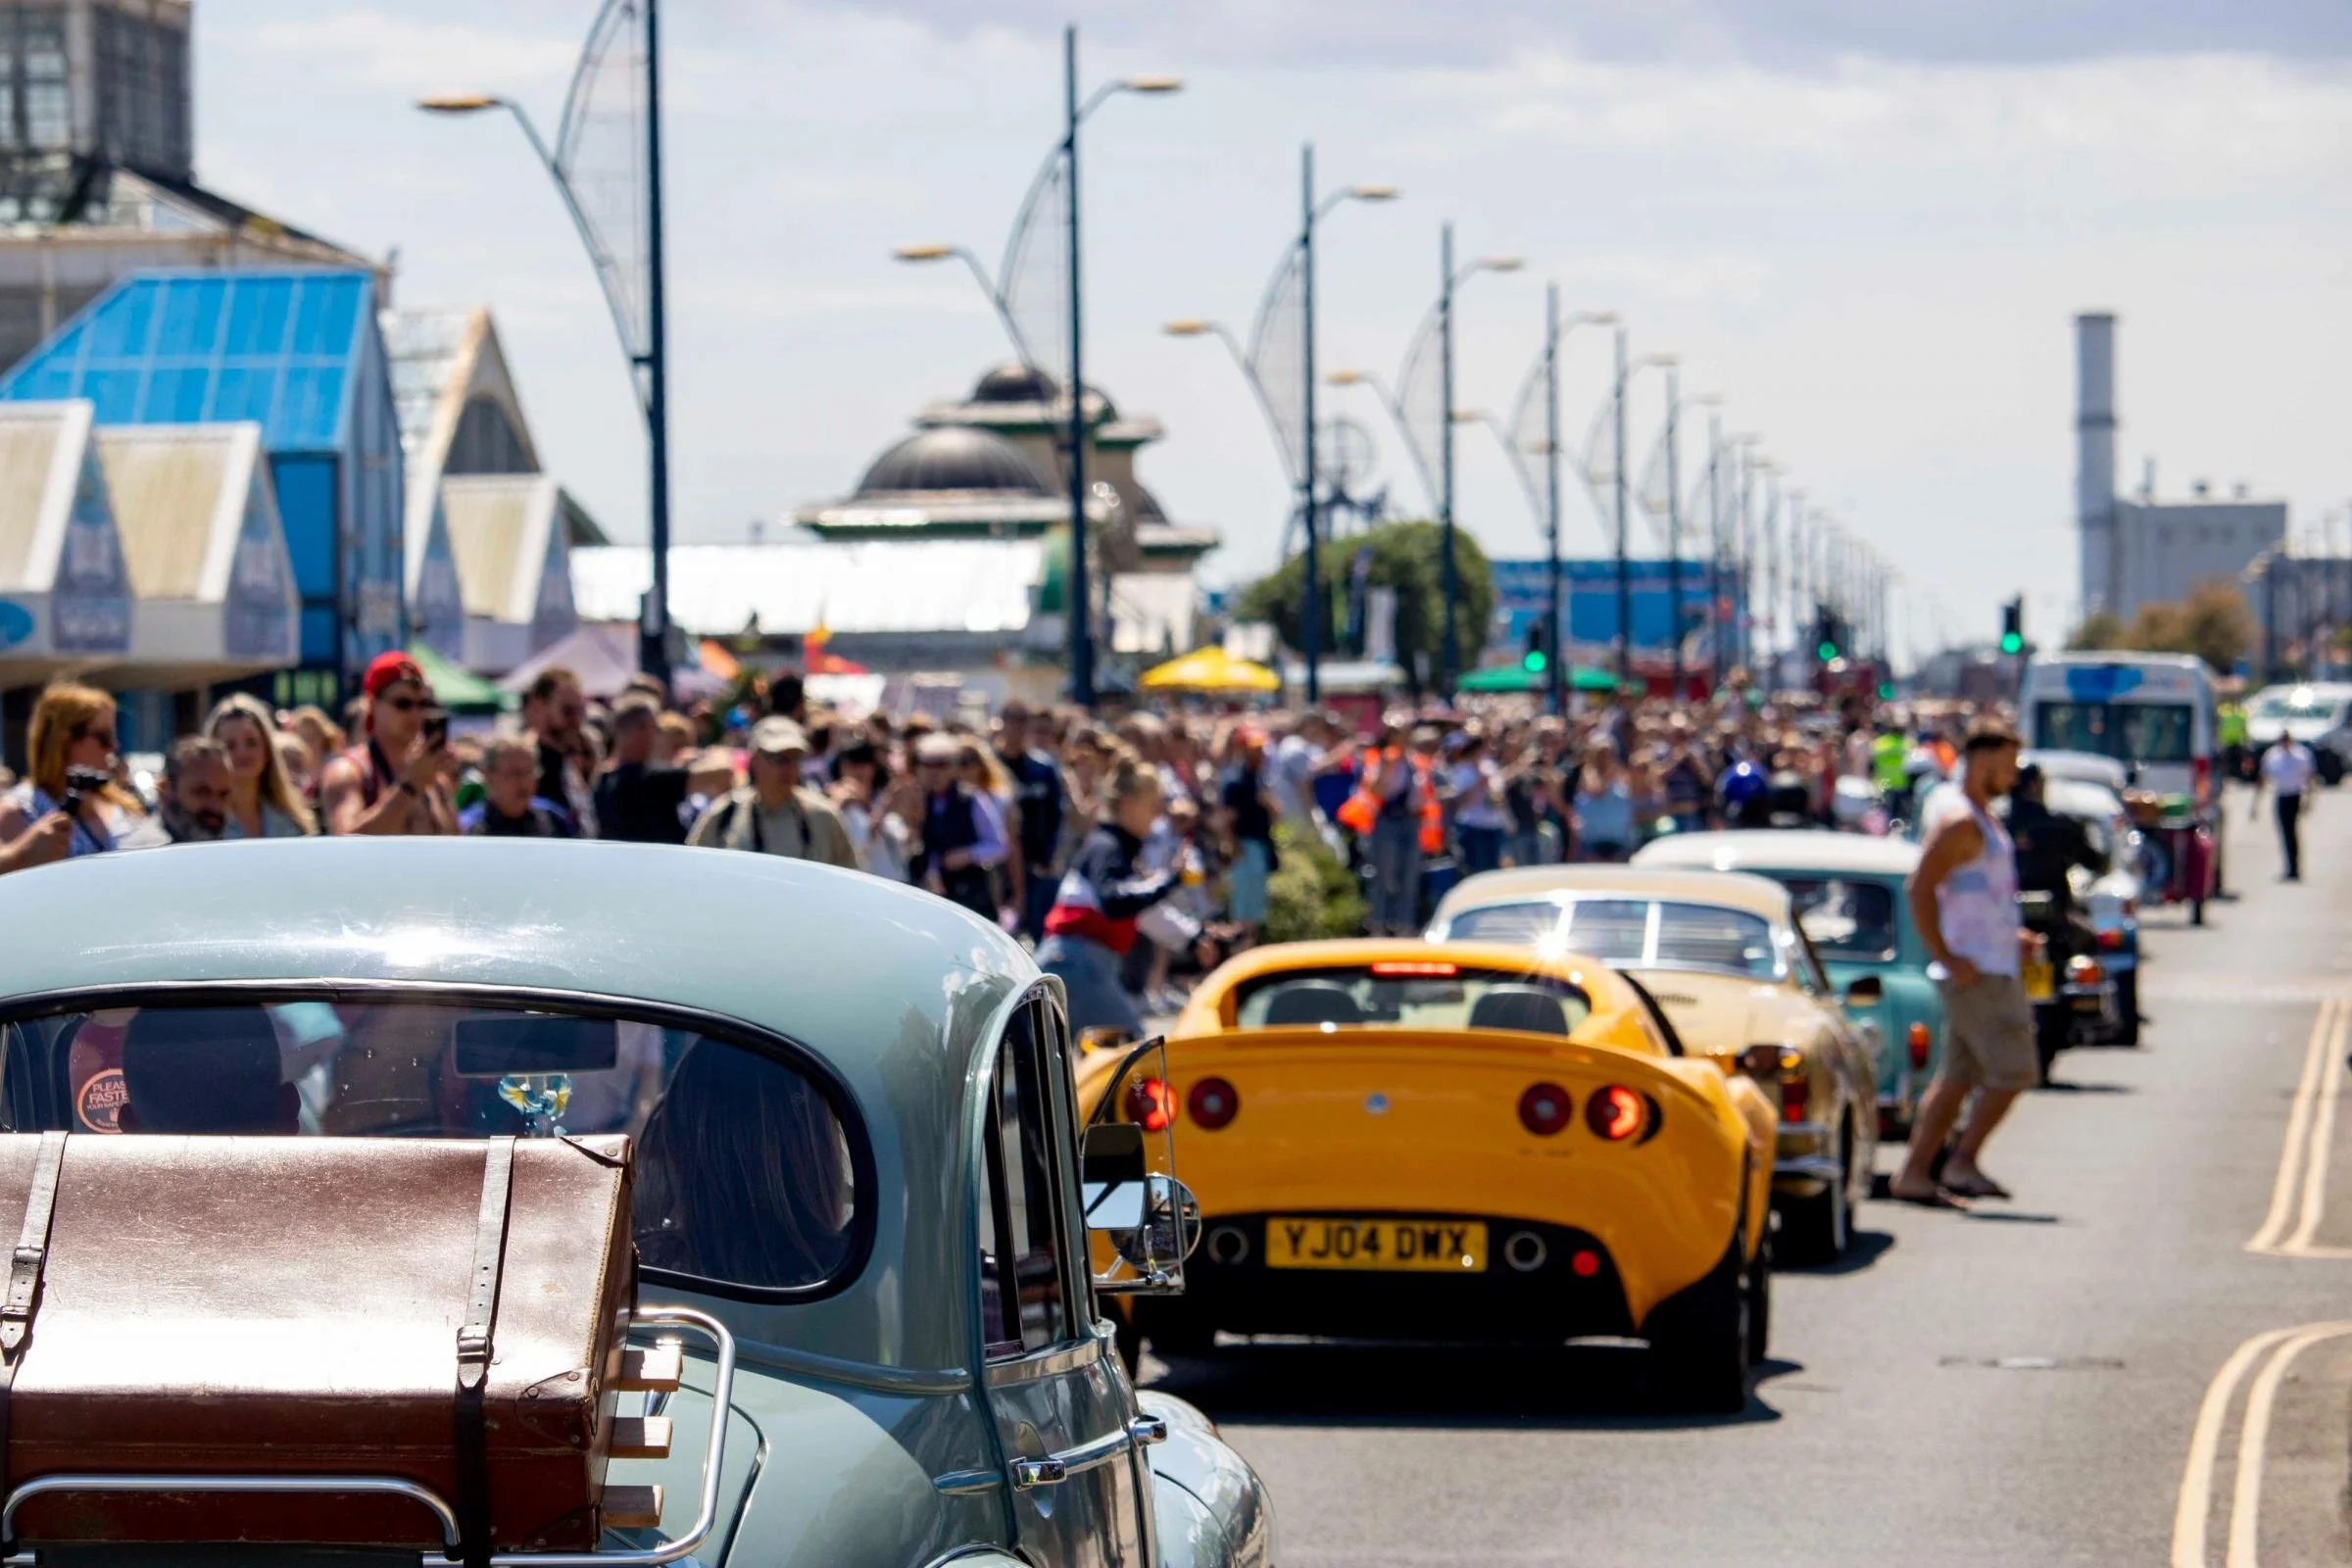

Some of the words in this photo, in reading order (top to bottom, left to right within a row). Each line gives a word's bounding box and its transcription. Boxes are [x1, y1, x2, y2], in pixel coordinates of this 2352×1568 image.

[92, 1081, 126, 1093] PLEAS
[89, 1090, 128, 1103] FASTE
[1285, 1223, 1381, 1259] YJ04
[1396, 1225, 1468, 1260] DWX
